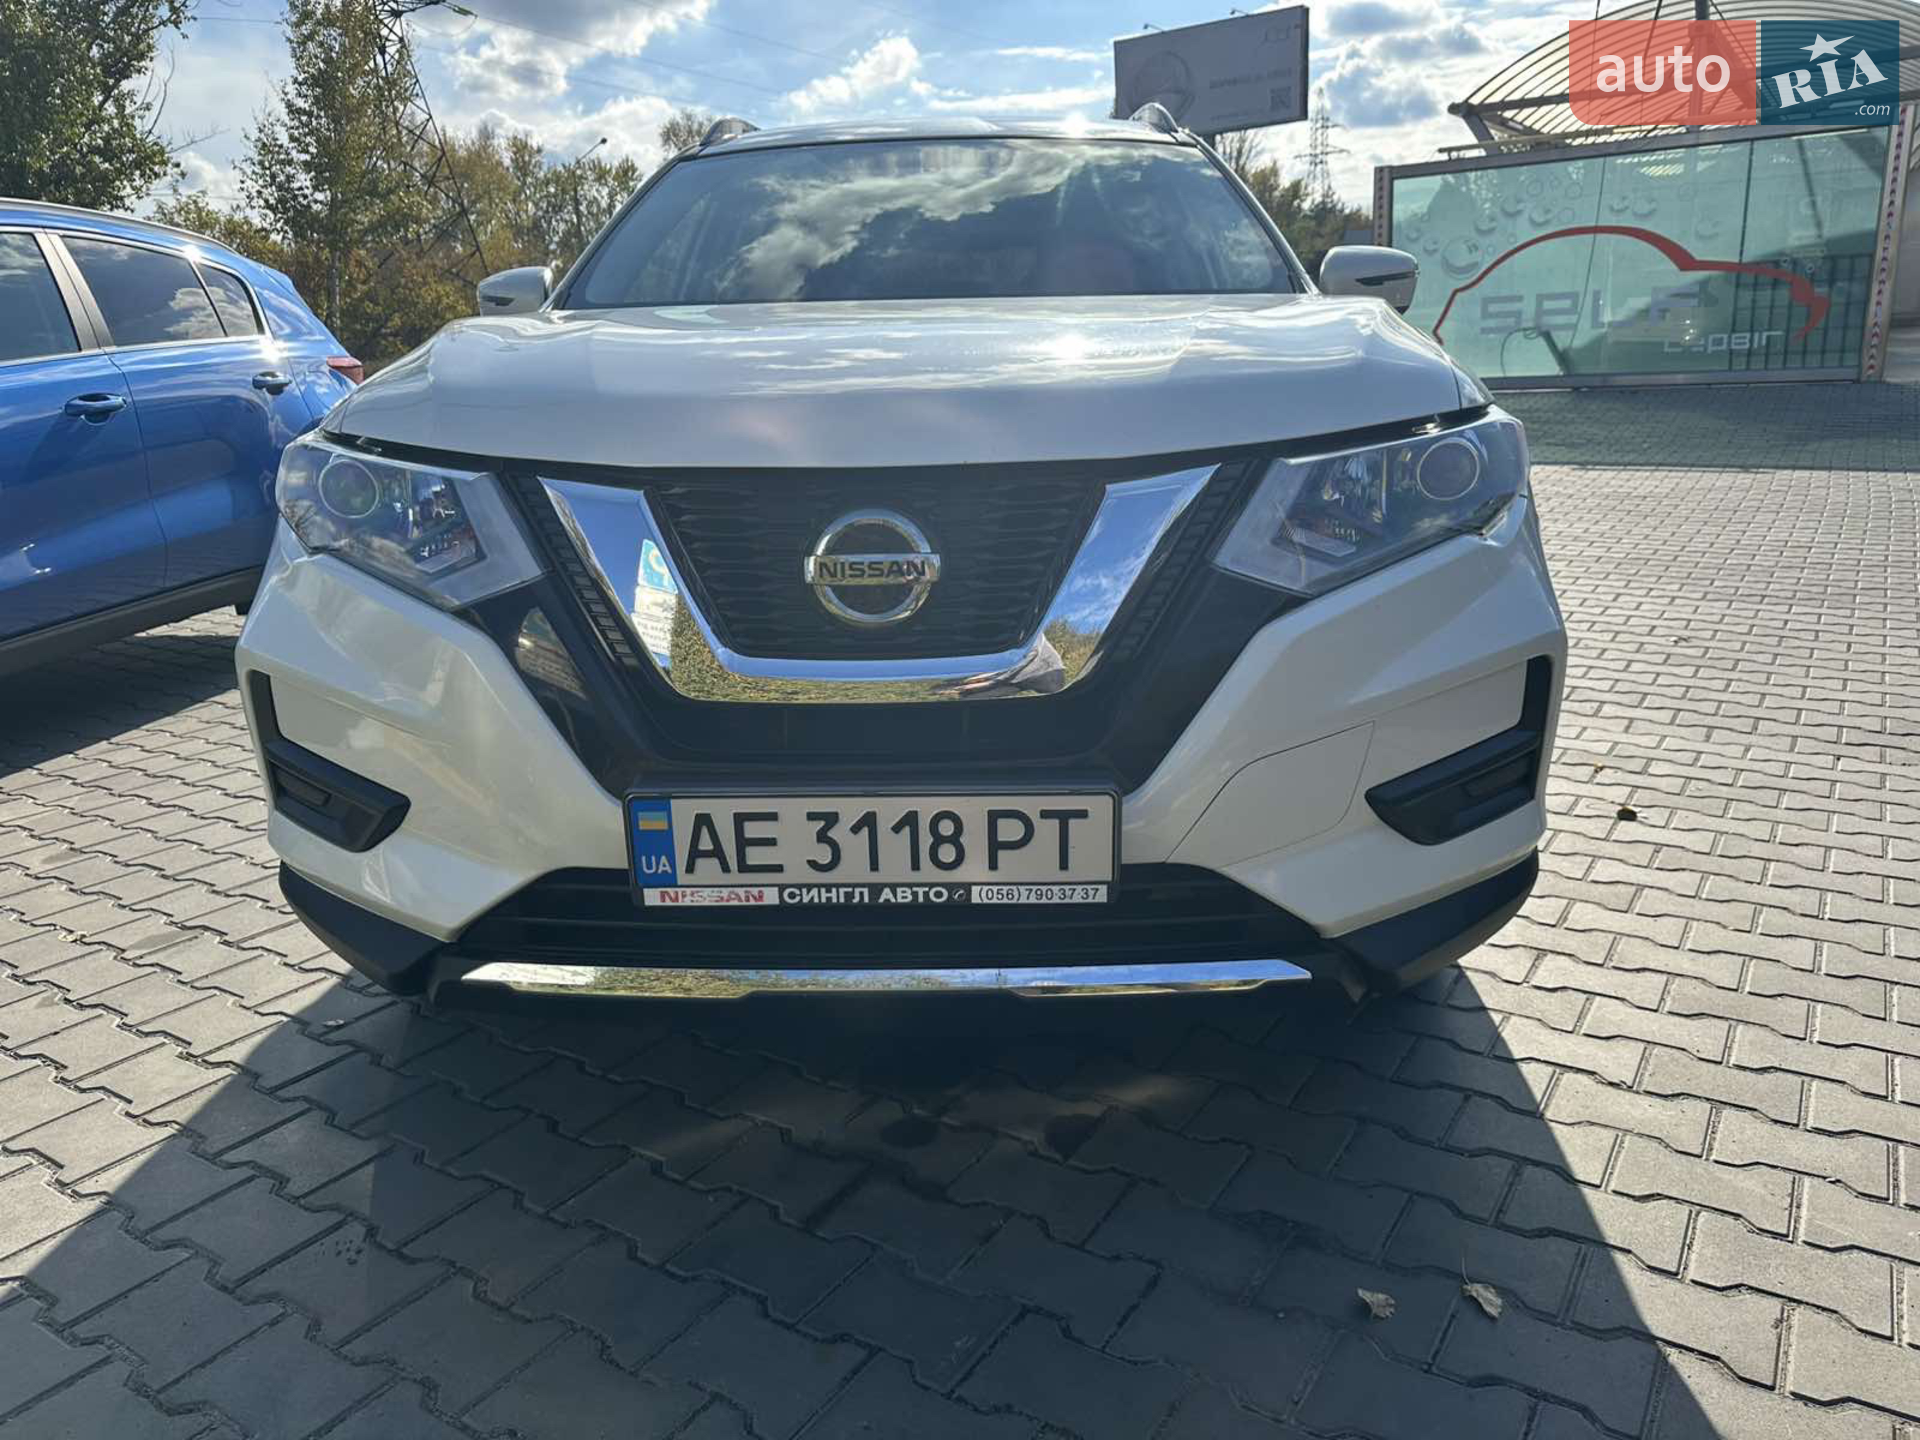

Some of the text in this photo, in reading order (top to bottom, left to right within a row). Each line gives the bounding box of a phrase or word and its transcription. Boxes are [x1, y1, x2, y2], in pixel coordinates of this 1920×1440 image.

[819, 560, 925, 578] NISSAN
[685, 808, 1089, 874] AE 3118 PT
[641, 855, 672, 874] UA
[659, 890, 765, 904] NISSAN
[782, 886, 948, 904] СИНГЛ АВТО
